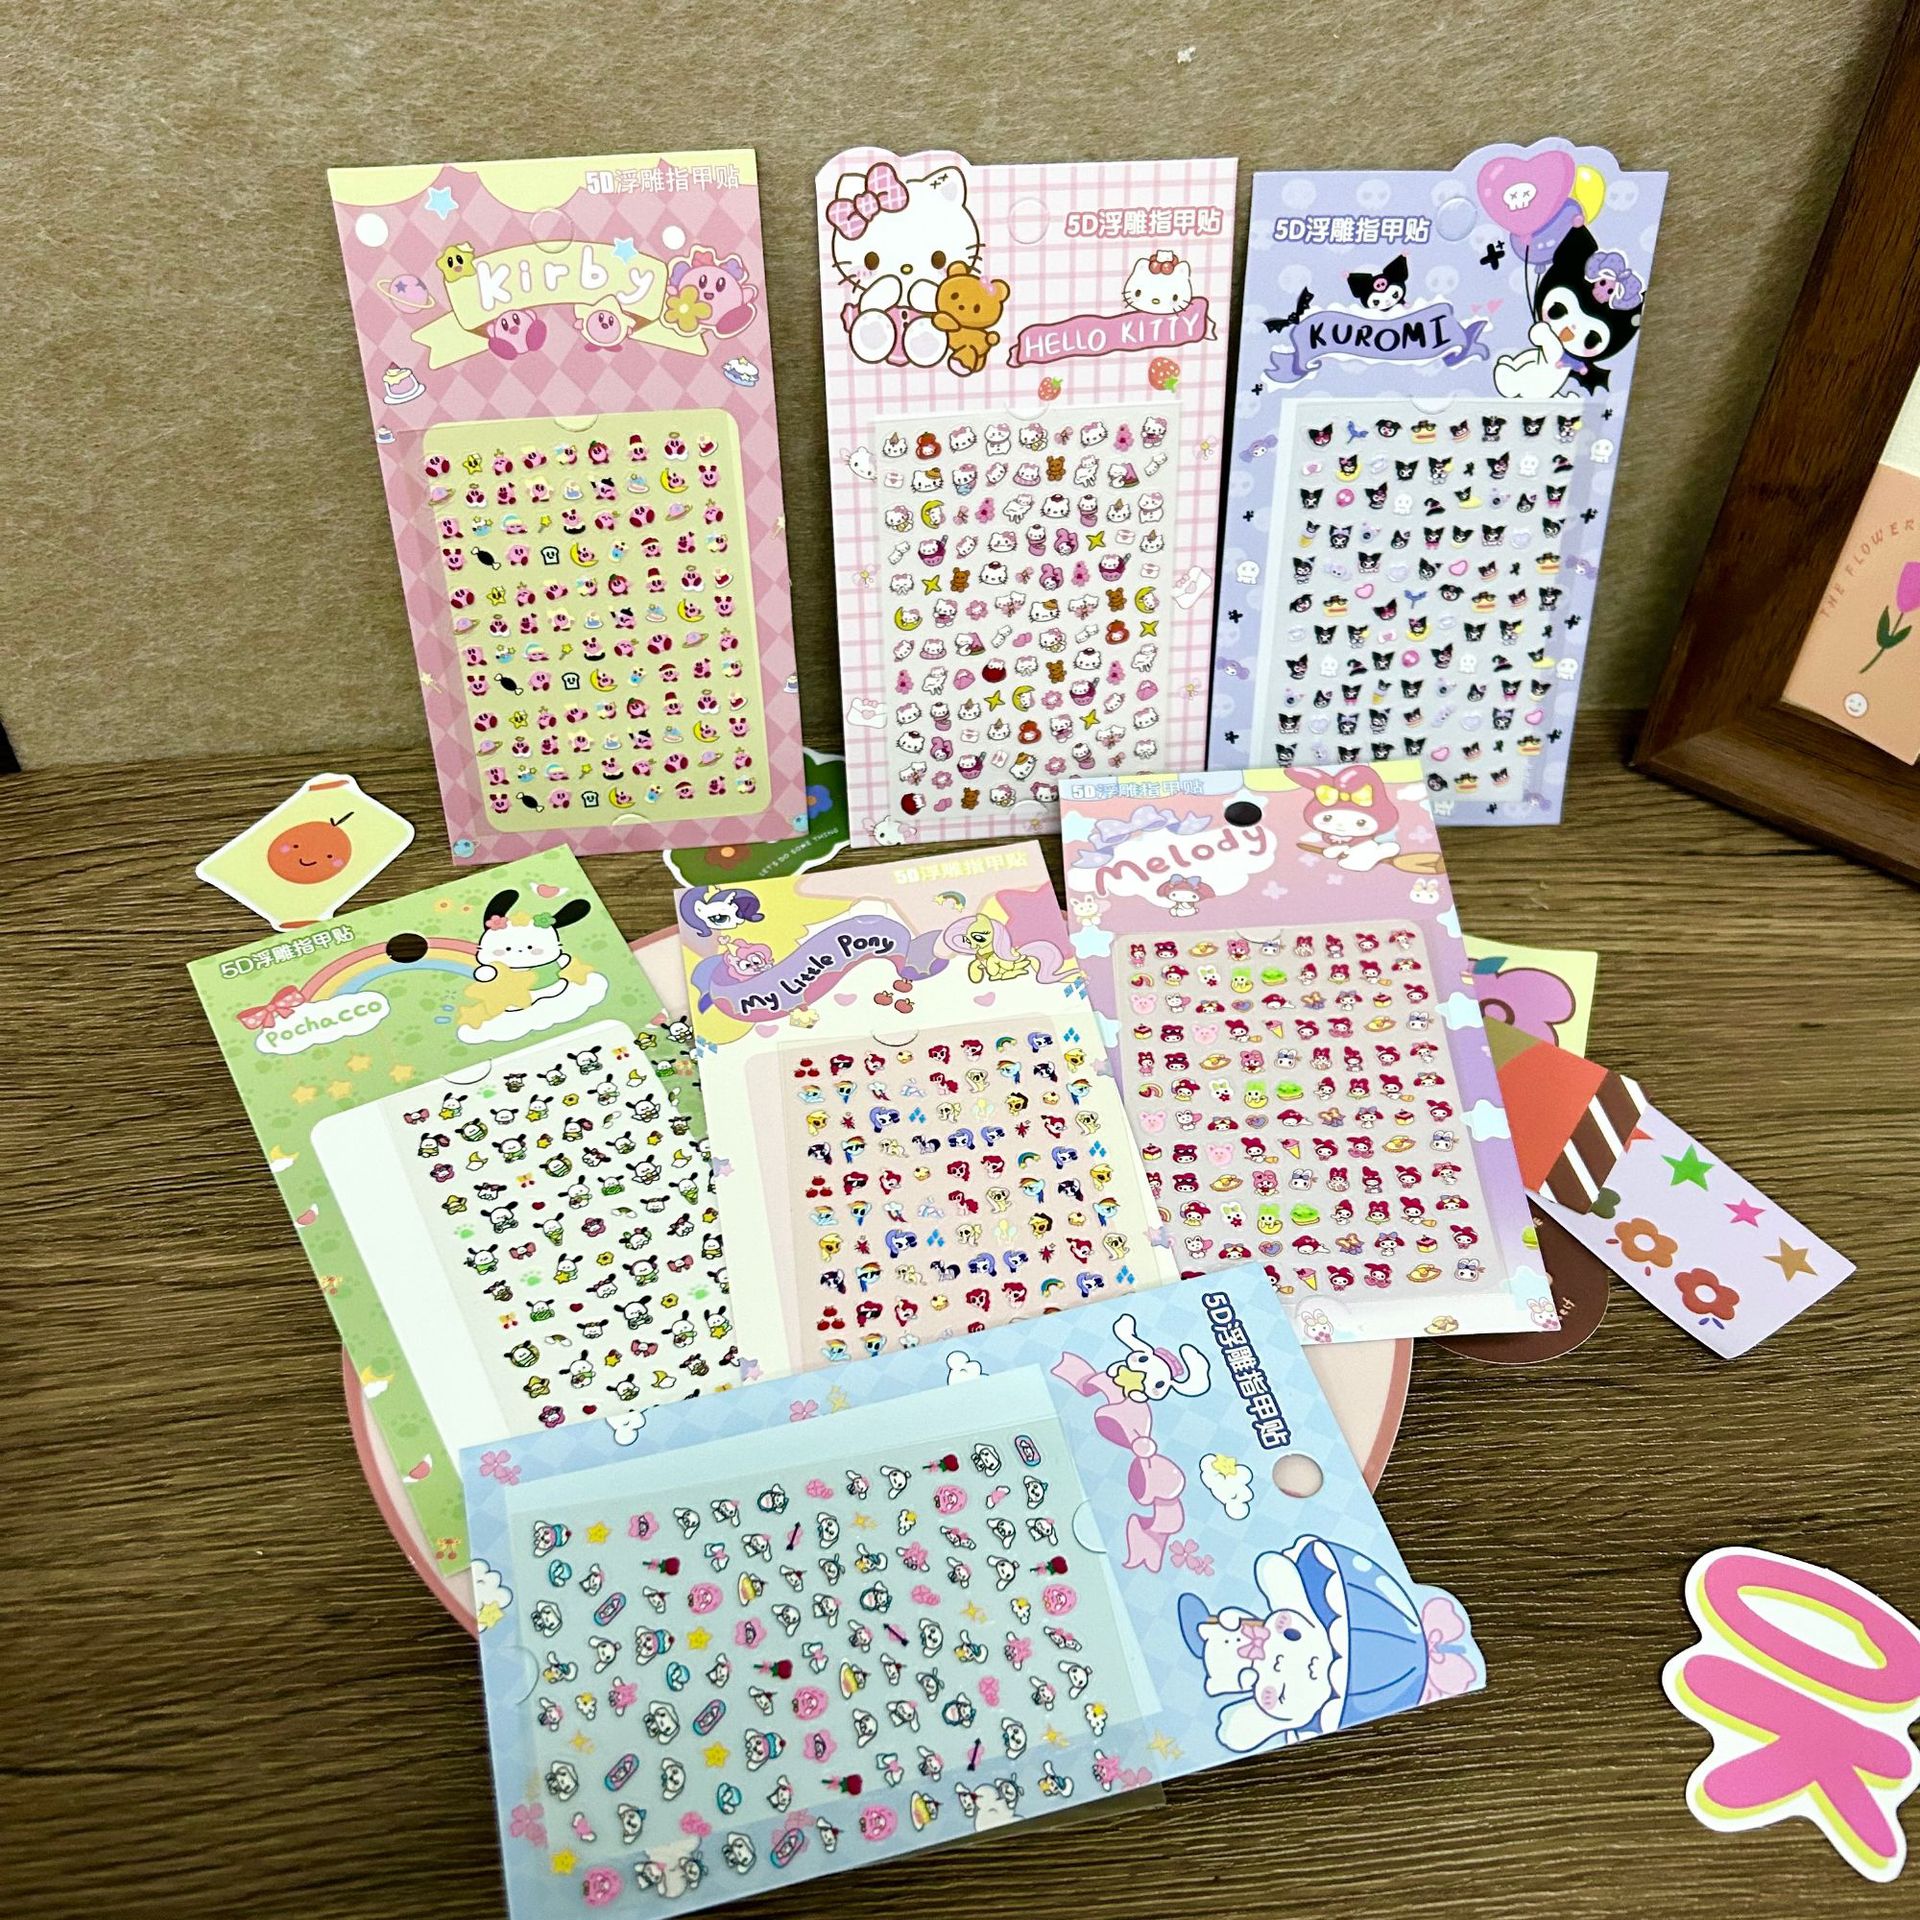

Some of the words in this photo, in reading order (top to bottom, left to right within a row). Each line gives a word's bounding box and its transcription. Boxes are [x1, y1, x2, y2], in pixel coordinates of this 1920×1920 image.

[585, 163, 741, 195] 5D浮雕指甲贴
[1065, 208, 1223, 238] 5D浮雕指甲贴
[1274, 216, 1431, 243] 5D浮雕指甲贴
[1024, 328, 1107, 359] HELLO
[1121, 313, 1201, 343] KITTY
[1309, 314, 1452, 352] KUROMI
[1820, 583, 1845, 618] THE
[1845, 519, 1915, 577] FLOWER
[1095, 826, 1267, 896] Melody
[220, 925, 355, 979] 5D浮雕指甲贴
[739, 991, 780, 1016] My
[780, 955, 834, 995] Little
[837, 932, 896, 959] Pony
[266, 1001, 382, 1047] Pochacco
[1201, 1291, 1291, 1450] 5D浮雕指甲贴
